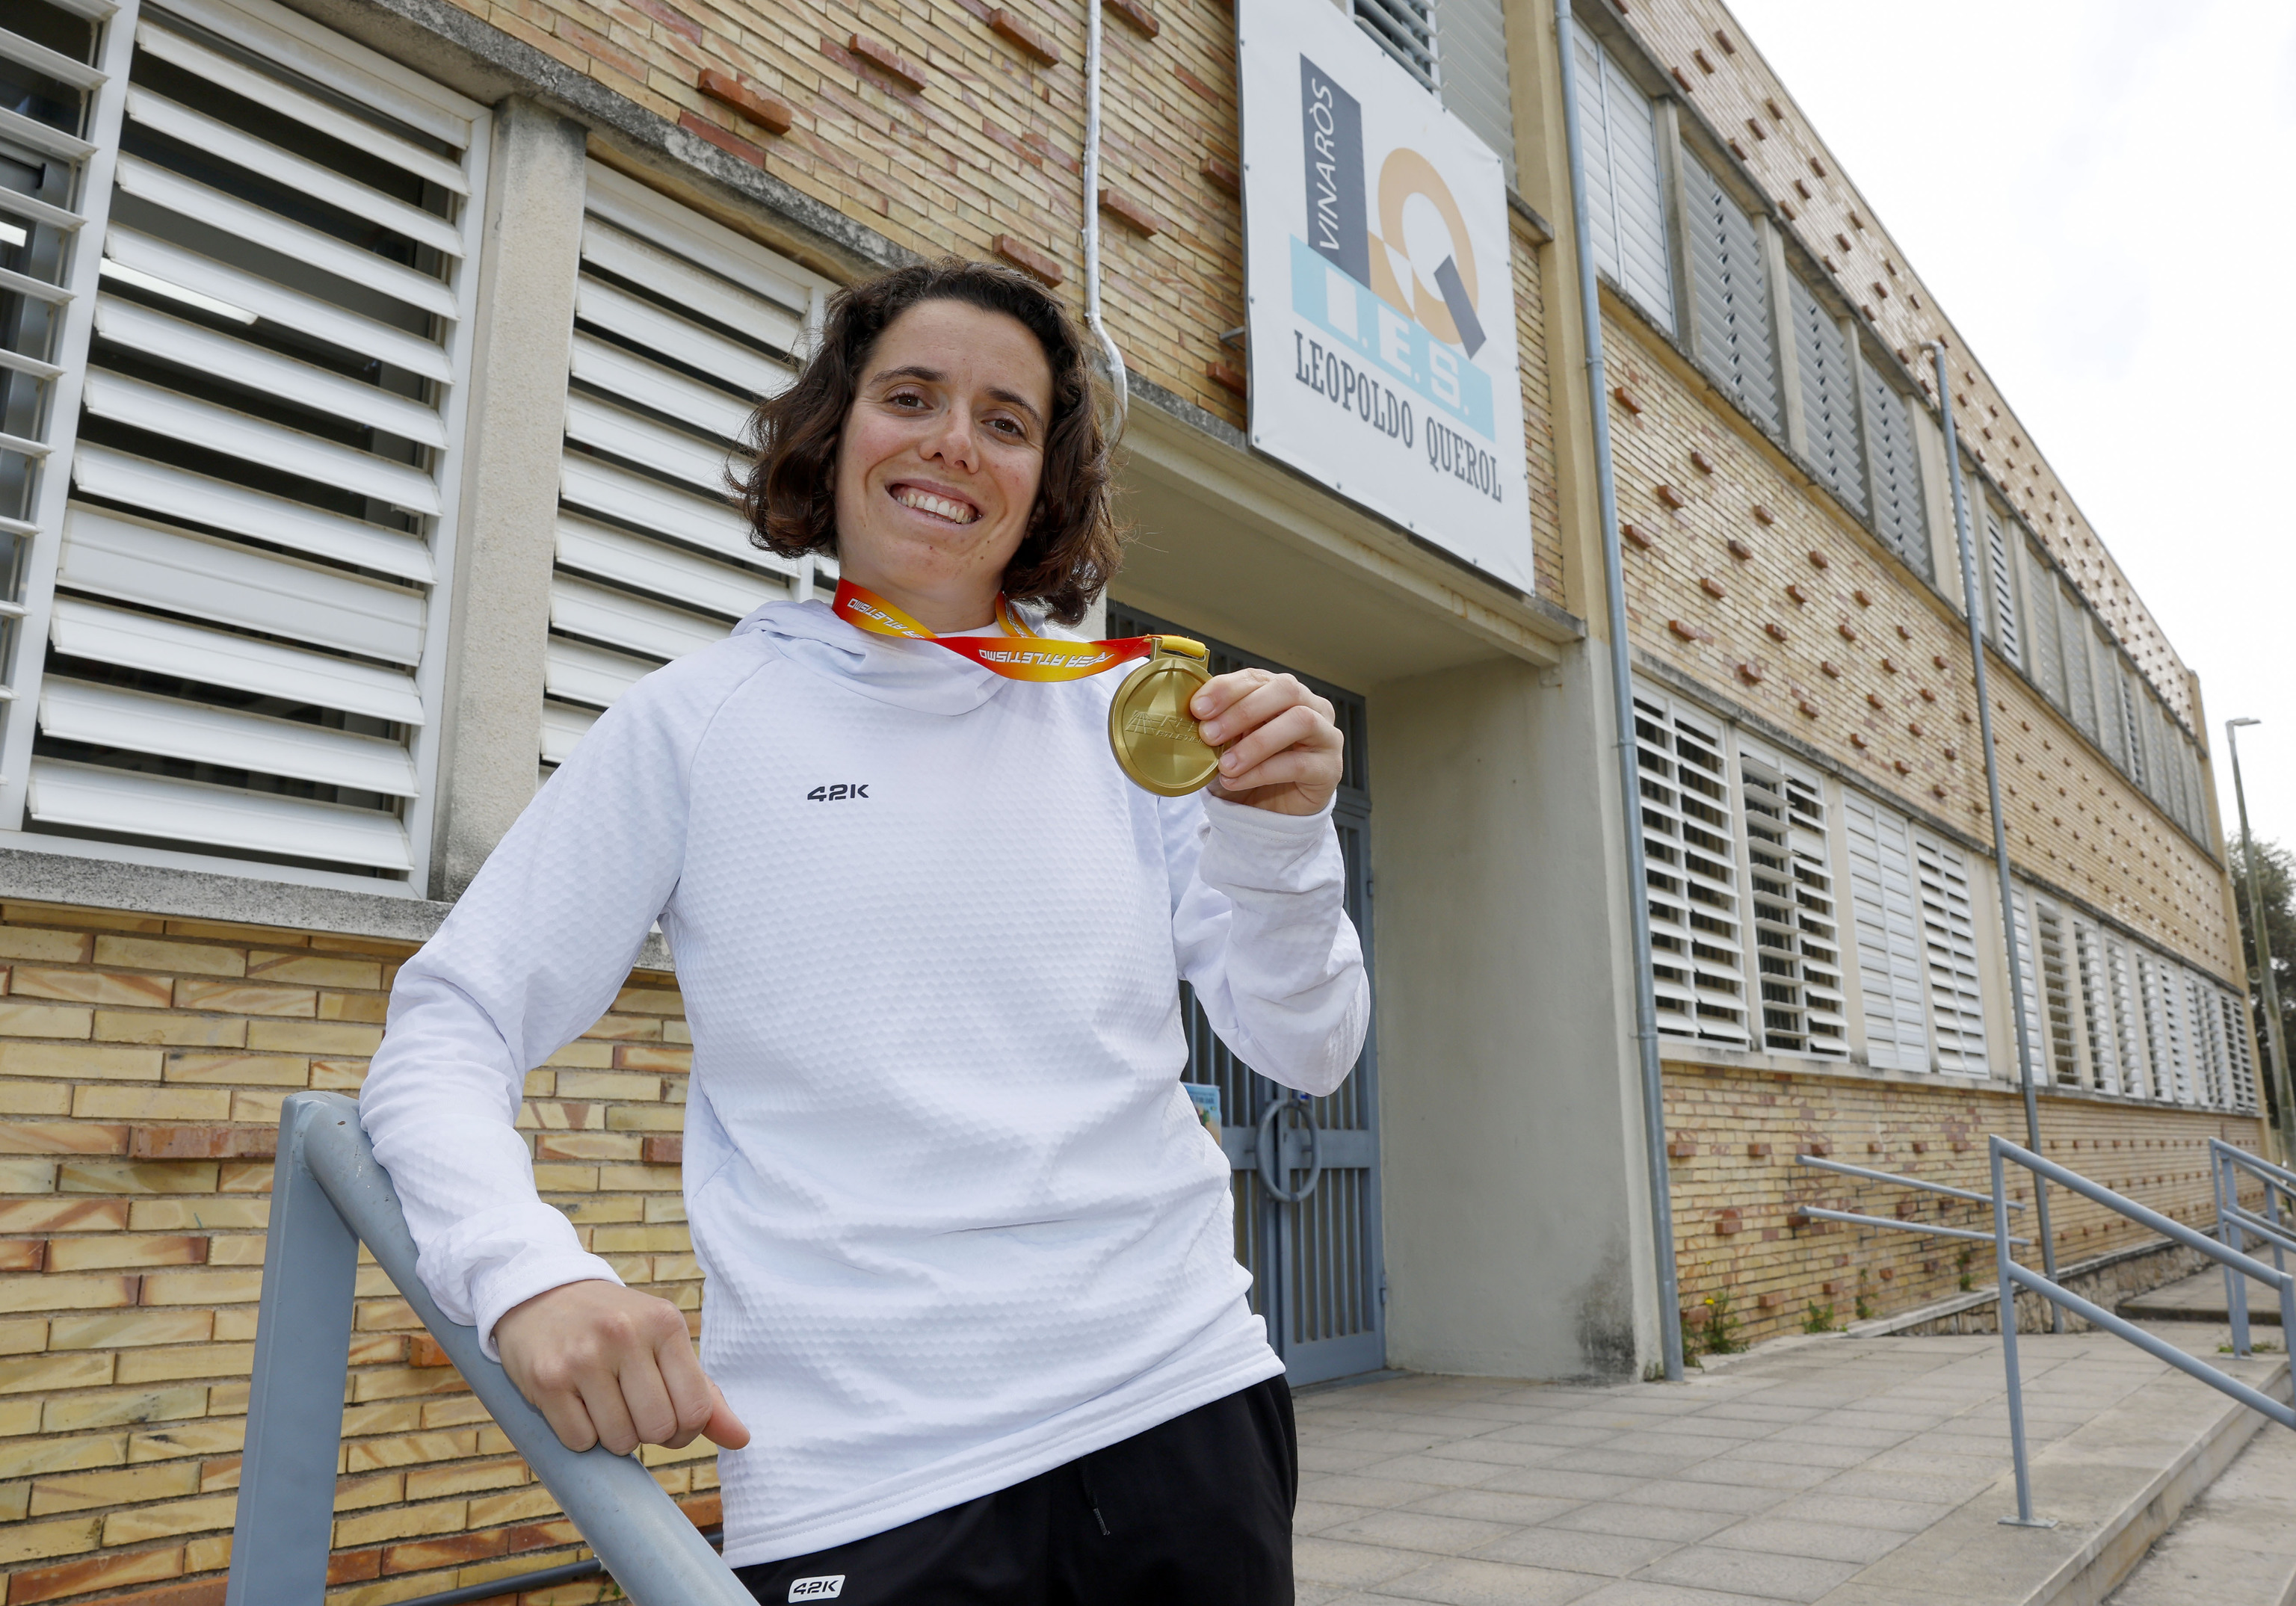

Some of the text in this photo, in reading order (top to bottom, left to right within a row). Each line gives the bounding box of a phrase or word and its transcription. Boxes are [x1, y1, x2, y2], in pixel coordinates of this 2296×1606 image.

[1309, 78, 1340, 250] VINARÒS
[1325, 265, 1470, 416] I.E.S.
[1294, 329, 1502, 504] LEOPOLDO QUEROL
[847, 598, 908, 630] ATLETISMO
[978, 649, 1066, 667] ATLETISMO
[807, 783, 869, 802] 42K
[793, 1580, 839, 1595] 42K
